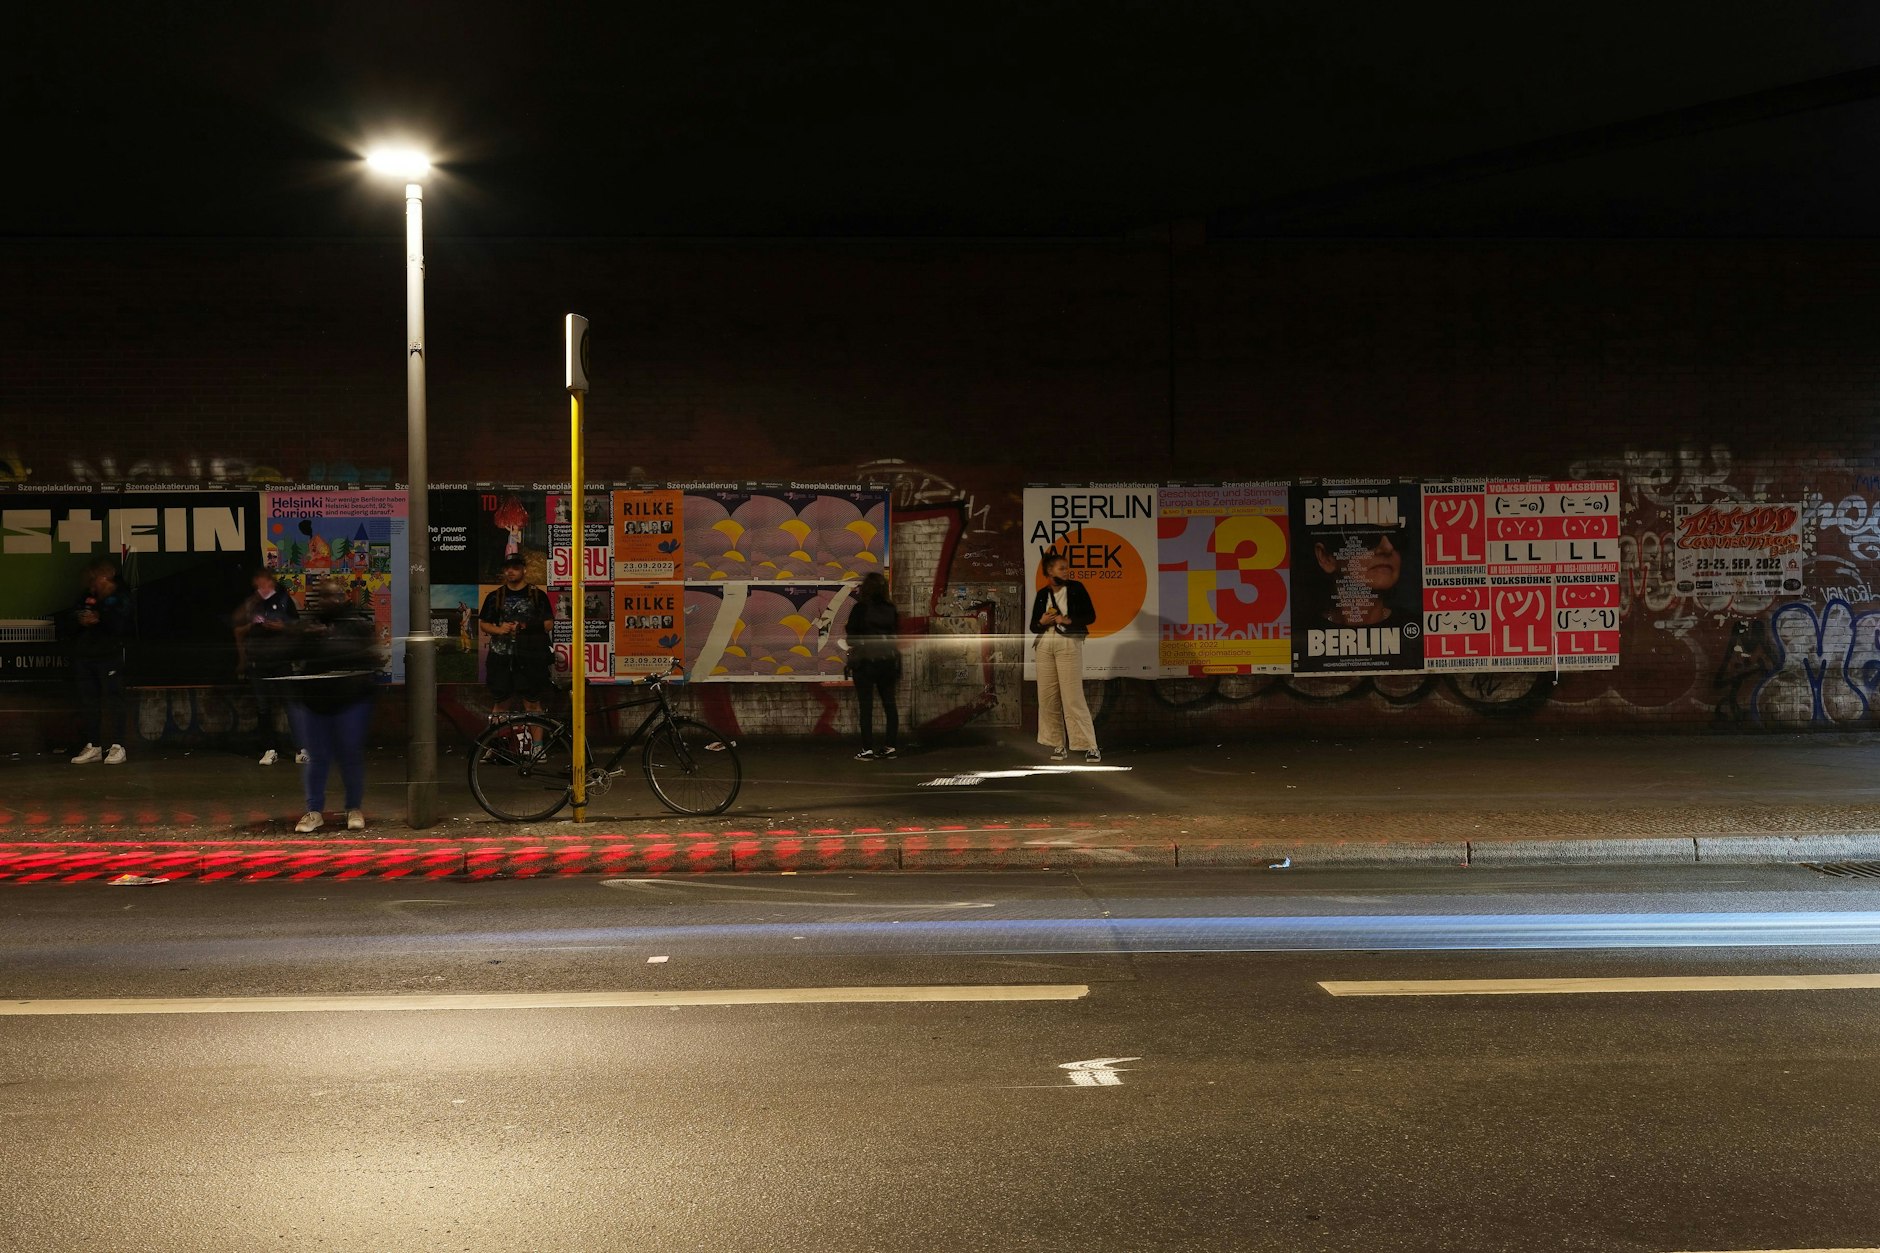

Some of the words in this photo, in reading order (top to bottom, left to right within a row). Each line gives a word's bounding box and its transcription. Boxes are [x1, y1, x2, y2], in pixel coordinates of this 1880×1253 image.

[125, 483, 200, 491] Szeneplakatierung
[394, 482, 468, 490] Szeakatierung
[532, 482, 605, 491] Szeneplakerung
[667, 482, 738, 491] Szeneplakatierung
[791, 482, 863, 492] Szeneplakatierung
[1321, 478, 1391, 486] Szeneplakatierung
[1554, 481, 1615, 492] VOLKSBÜHNE
[17, 483, 93, 493] Szeneplakatierung
[264, 484, 340, 492] Szeneplakatierung
[1158, 489, 1220, 498] Geschichten
[1222, 489, 1241, 498] und
[1243, 488, 1288, 497] Stimmen
[1424, 484, 1485, 494] VOLKSBÜHNE
[1489, 483, 1551, 493] VOLKSBÜHNE
[272, 496, 323, 509] Helsinki
[1051, 495, 1152, 518] BERLIN
[1159, 498, 1194, 507] Europa
[1195, 498, 1210, 506] bis
[1212, 497, 1272, 506] Zentralasien
[272, 508, 323, 518] Curious
[623, 502, 674, 516] RILKE
[1304, 496, 1407, 529] BERLIN,
[1676, 506, 1692, 515] 30.
[1676, 504, 1799, 537] TATTOO
[428, 525, 439, 533] he
[440, 526, 467, 534] power
[1030, 520, 1089, 544] ART
[432, 535, 441, 543] of
[443, 535, 467, 543] music
[1697, 558, 1729, 569] 23-25.
[1732, 558, 1753, 569] SEP.
[1756, 558, 1781, 569] 2022
[1079, 571, 1099, 580] SEP
[1101, 571, 1124, 580] 2022
[1425, 567, 1433, 575] AM
[1426, 576, 1487, 586] VOLKSBÜHNE
[1491, 575, 1551, 585] VOLKSBÜHNE
[1556, 574, 1616, 584] VOLKSBÜHNE
[624, 597, 674, 610] RILKE
[1406, 626, 1417, 635] HS
[1199, 641, 1218, 649] 2022
[1307, 627, 1401, 656] BERLIN
[1161, 649, 1172, 657] 30
[1173, 649, 1197, 657] Jahre
[1198, 648, 1252, 658] diplomatische
[1162, 658, 1212, 666] Beziehungen
[1427, 659, 1434, 667] AM
[1492, 658, 1498, 666] AM
